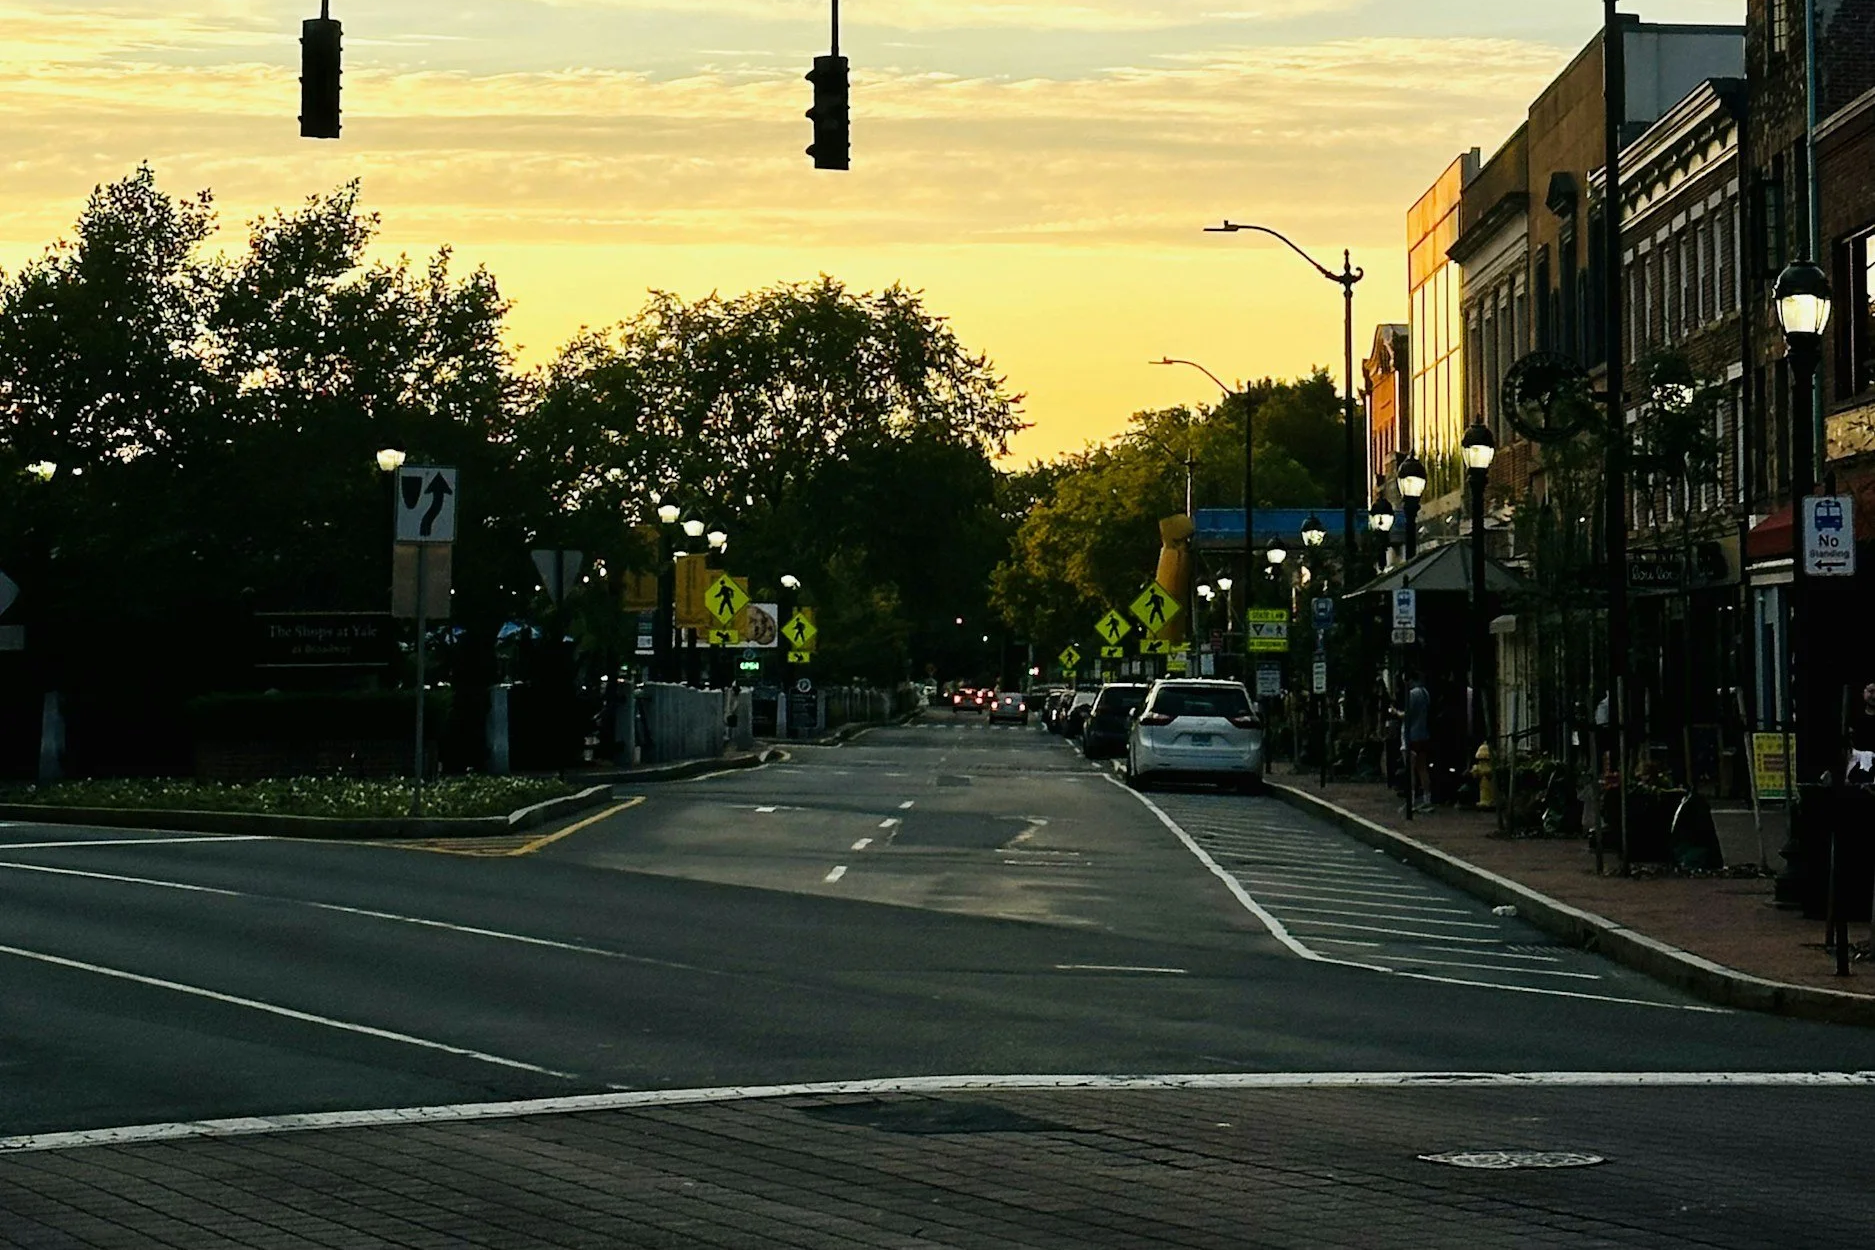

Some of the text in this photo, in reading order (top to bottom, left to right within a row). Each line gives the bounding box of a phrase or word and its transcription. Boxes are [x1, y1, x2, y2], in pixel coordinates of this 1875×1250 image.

[1819, 534, 1839, 547] No
[1809, 549, 1850, 559] Standing
[268, 622, 378, 642] The Shops at Yale
